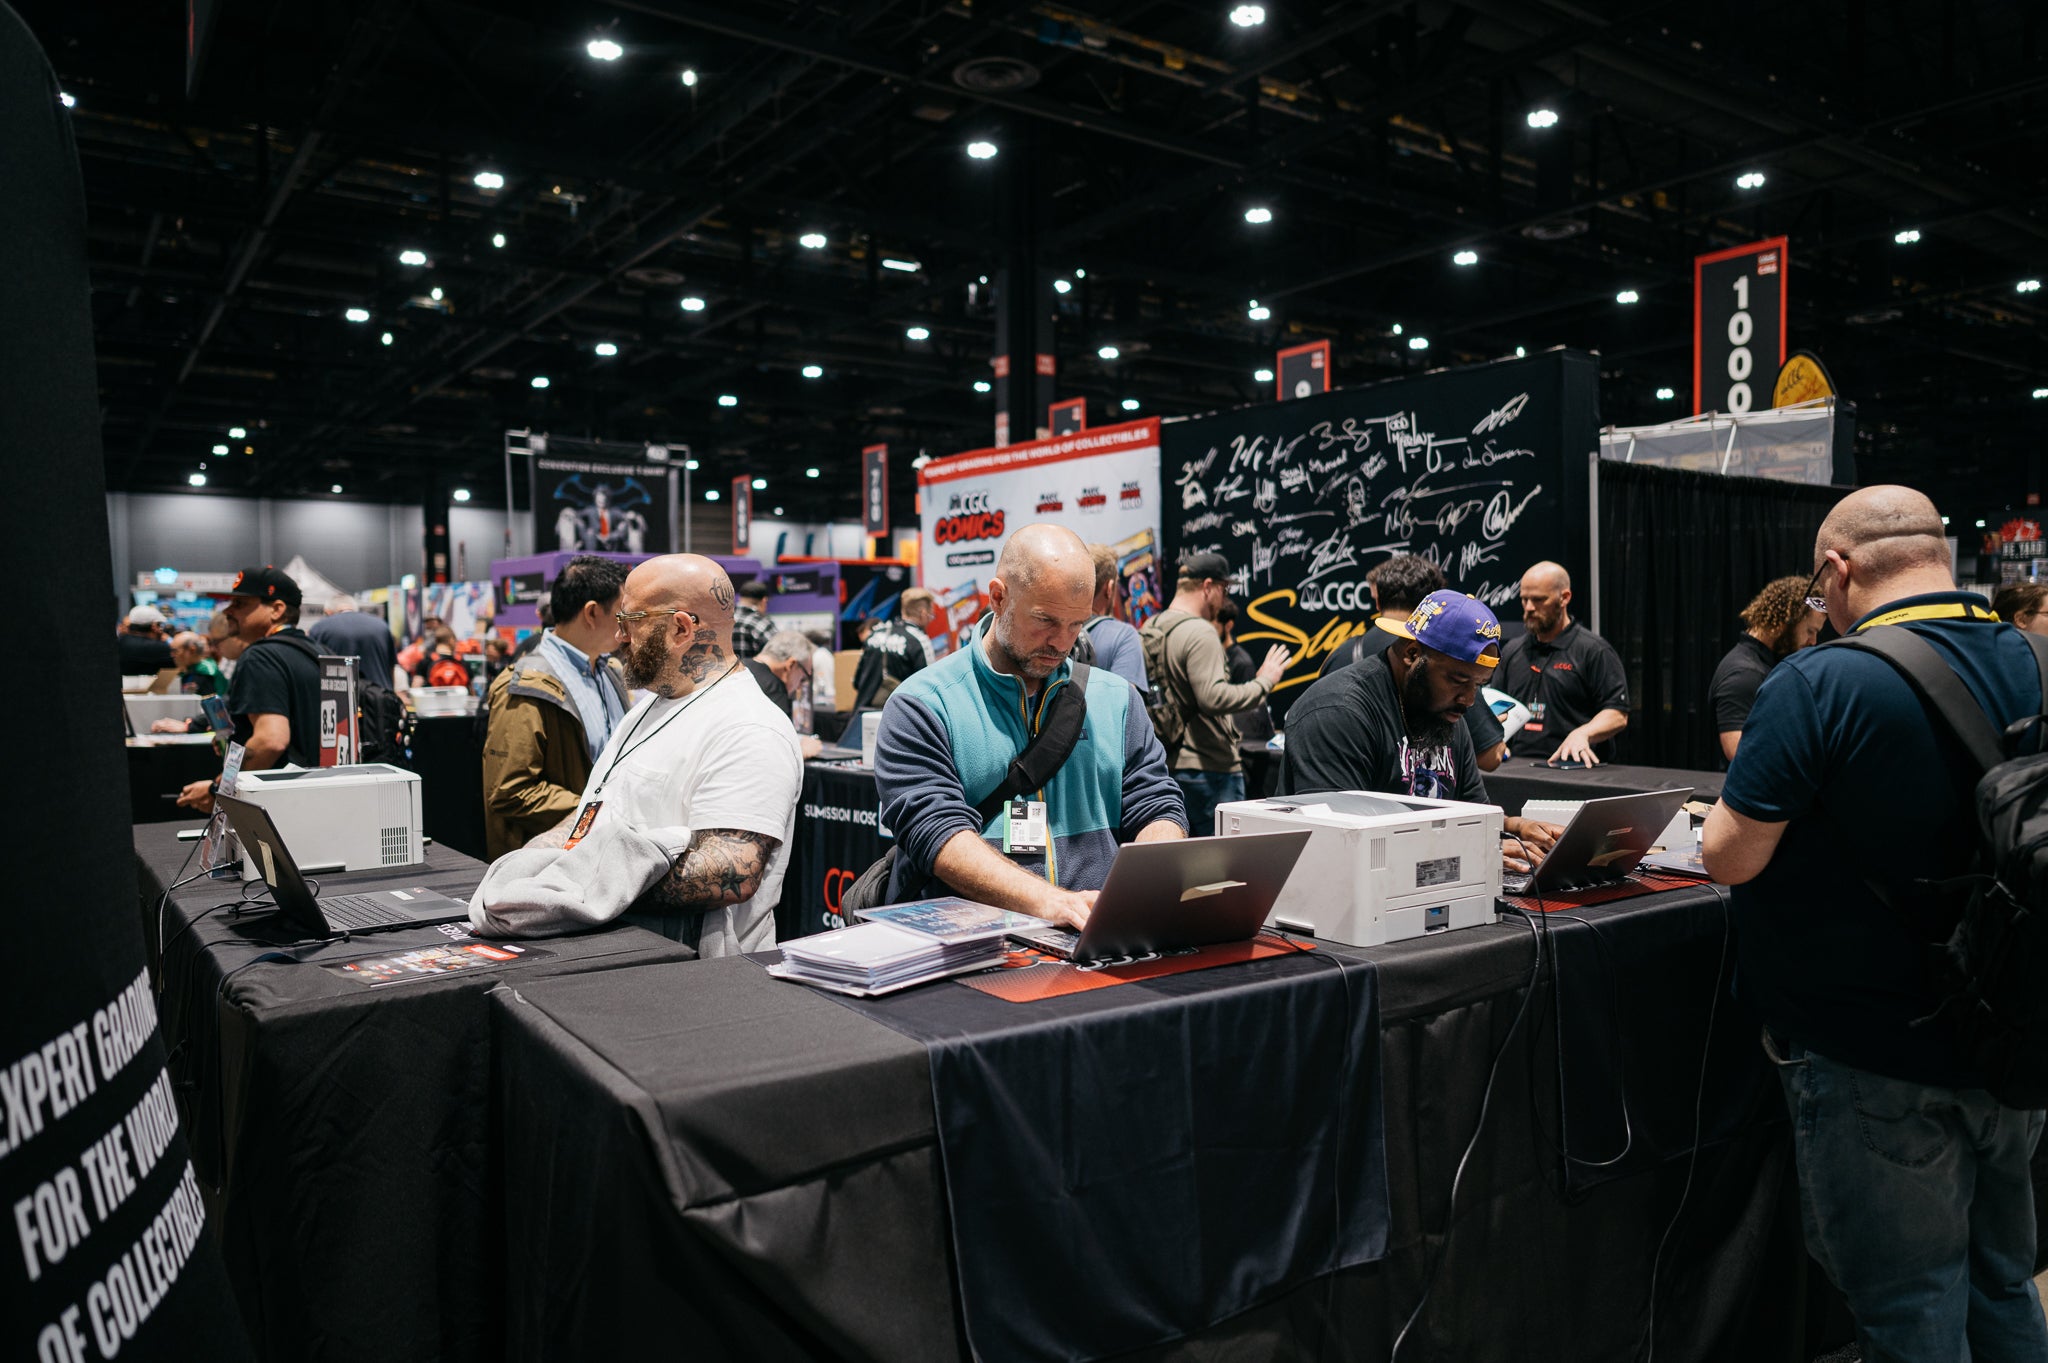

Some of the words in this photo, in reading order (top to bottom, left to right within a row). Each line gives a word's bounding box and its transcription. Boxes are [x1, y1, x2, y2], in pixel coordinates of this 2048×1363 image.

[1727, 276, 1754, 413] 1000
[993, 454, 1011, 467] FOR
[1012, 450, 1029, 463] THE
[1029, 444, 1061, 460] WORLD
[1061, 440, 1075, 454] OF
[1075, 427, 1150, 451] COLLECTIBLES
[961, 490, 989, 515] CGC
[935, 509, 1005, 545] COMICS
[1323, 581, 1372, 611] CGC
[322, 708, 336, 735] 8.5
[93, 965, 159, 1083] GRADING
[13, 1166, 91, 1282] FOR
[80, 1121, 136, 1223] THE
[126, 1066, 180, 1179] WORLD
[87, 1158, 206, 1361] COLLECTIBLES
